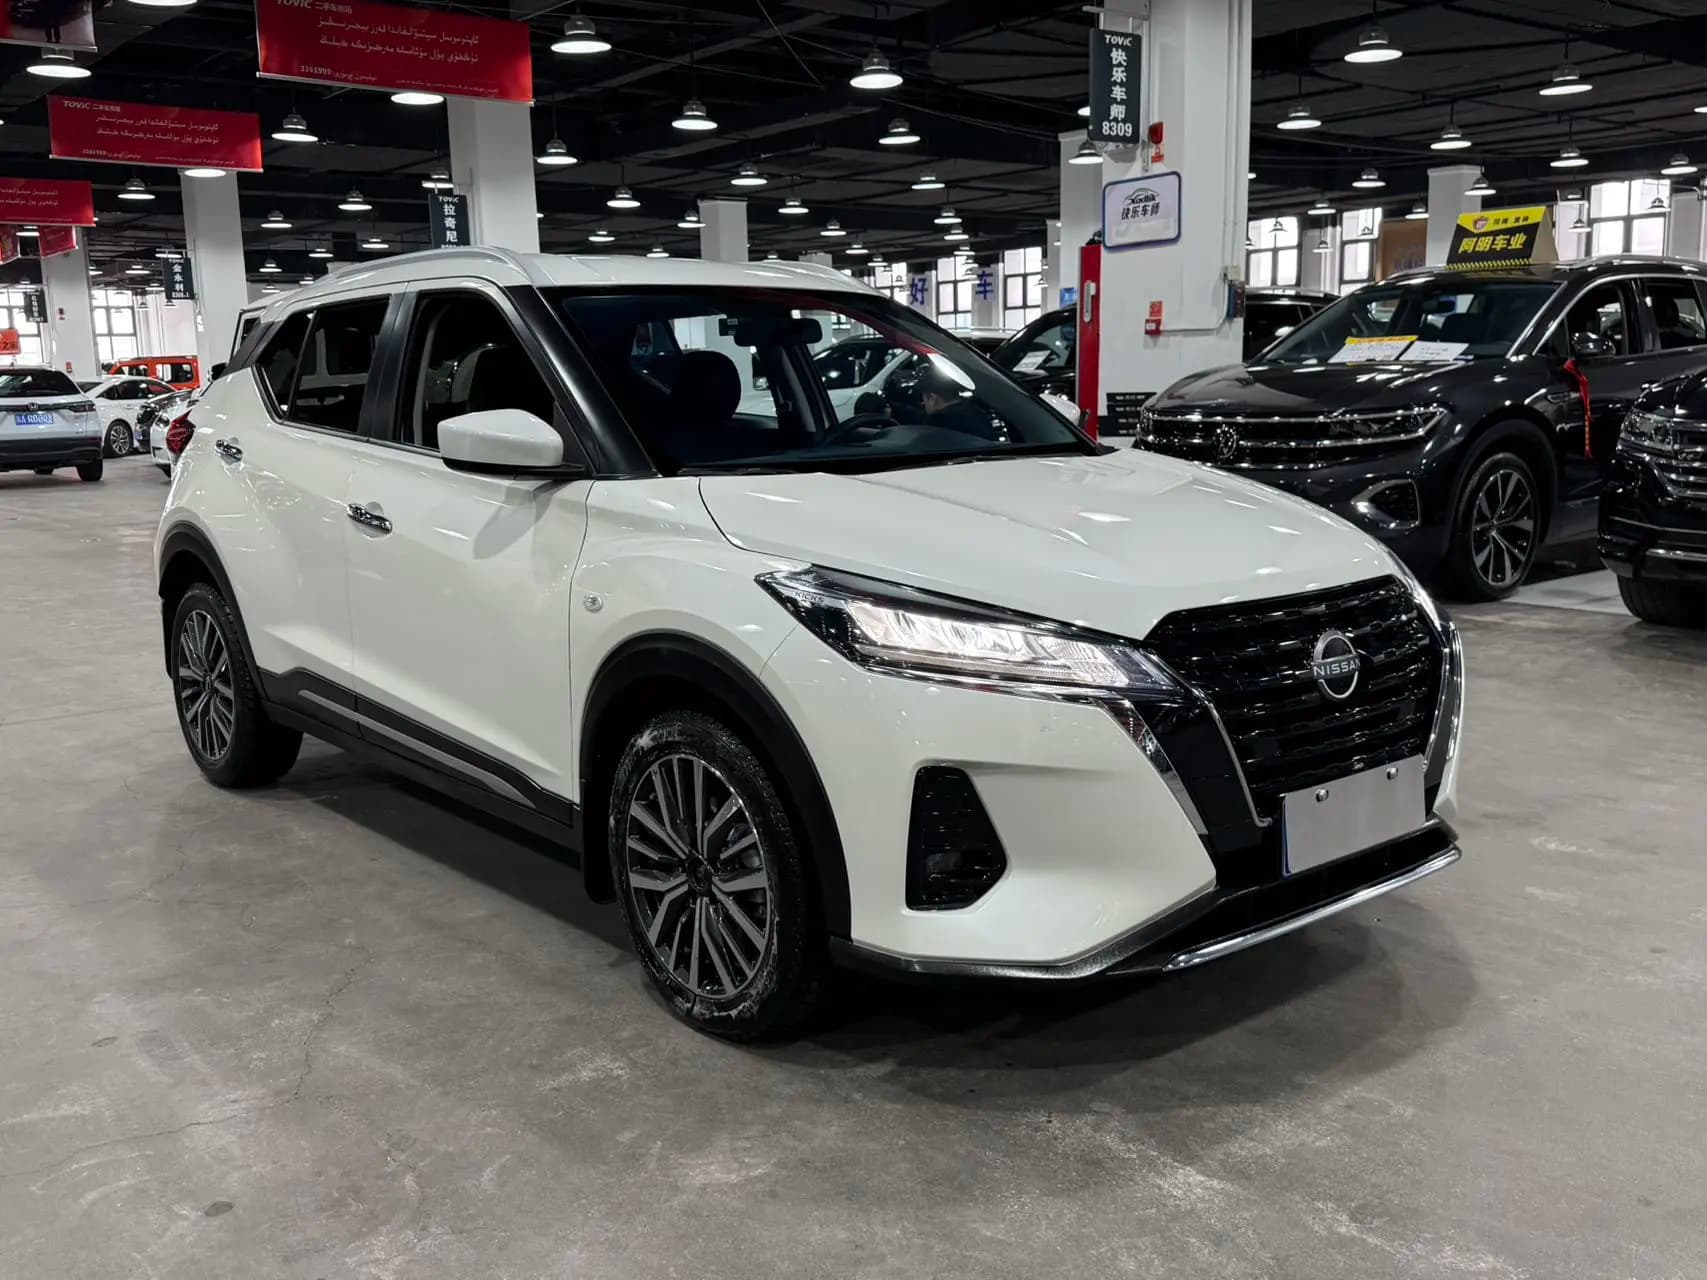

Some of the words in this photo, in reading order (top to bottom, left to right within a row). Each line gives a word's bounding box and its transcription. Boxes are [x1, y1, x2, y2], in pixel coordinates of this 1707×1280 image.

[1104, 34, 1133, 46] TOVIC
[1109, 47, 1128, 121] 快乐车师
[1102, 121, 1133, 137] 8309
[1121, 202, 1161, 221] 快乐车师
[1458, 232, 1527, 254] 阿明车业
[911, 278, 928, 305] 好
[976, 270, 994, 300] 车
[794, 591, 825, 603] KICKS
